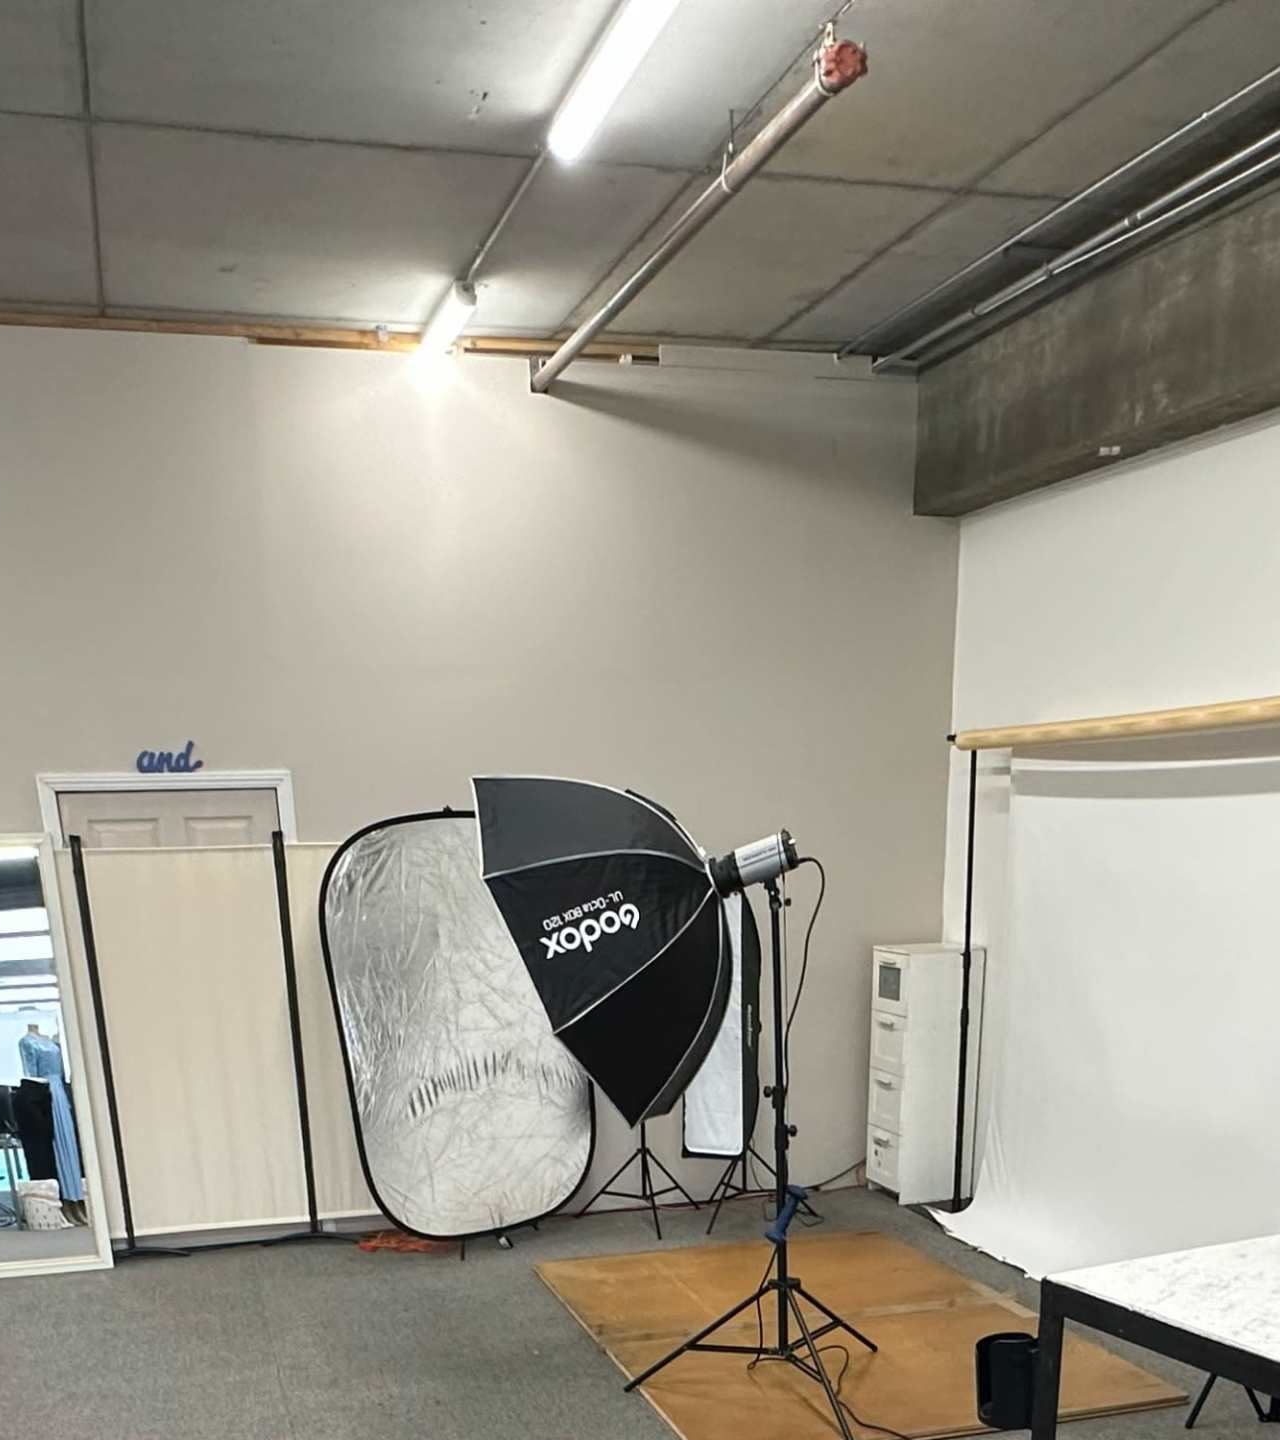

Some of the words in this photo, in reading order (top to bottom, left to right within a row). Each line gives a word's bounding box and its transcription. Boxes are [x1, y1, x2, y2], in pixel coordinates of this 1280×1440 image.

[136, 740, 204, 773] and
[539, 903, 640, 960] Godox
[542, 915, 564, 931] 120
